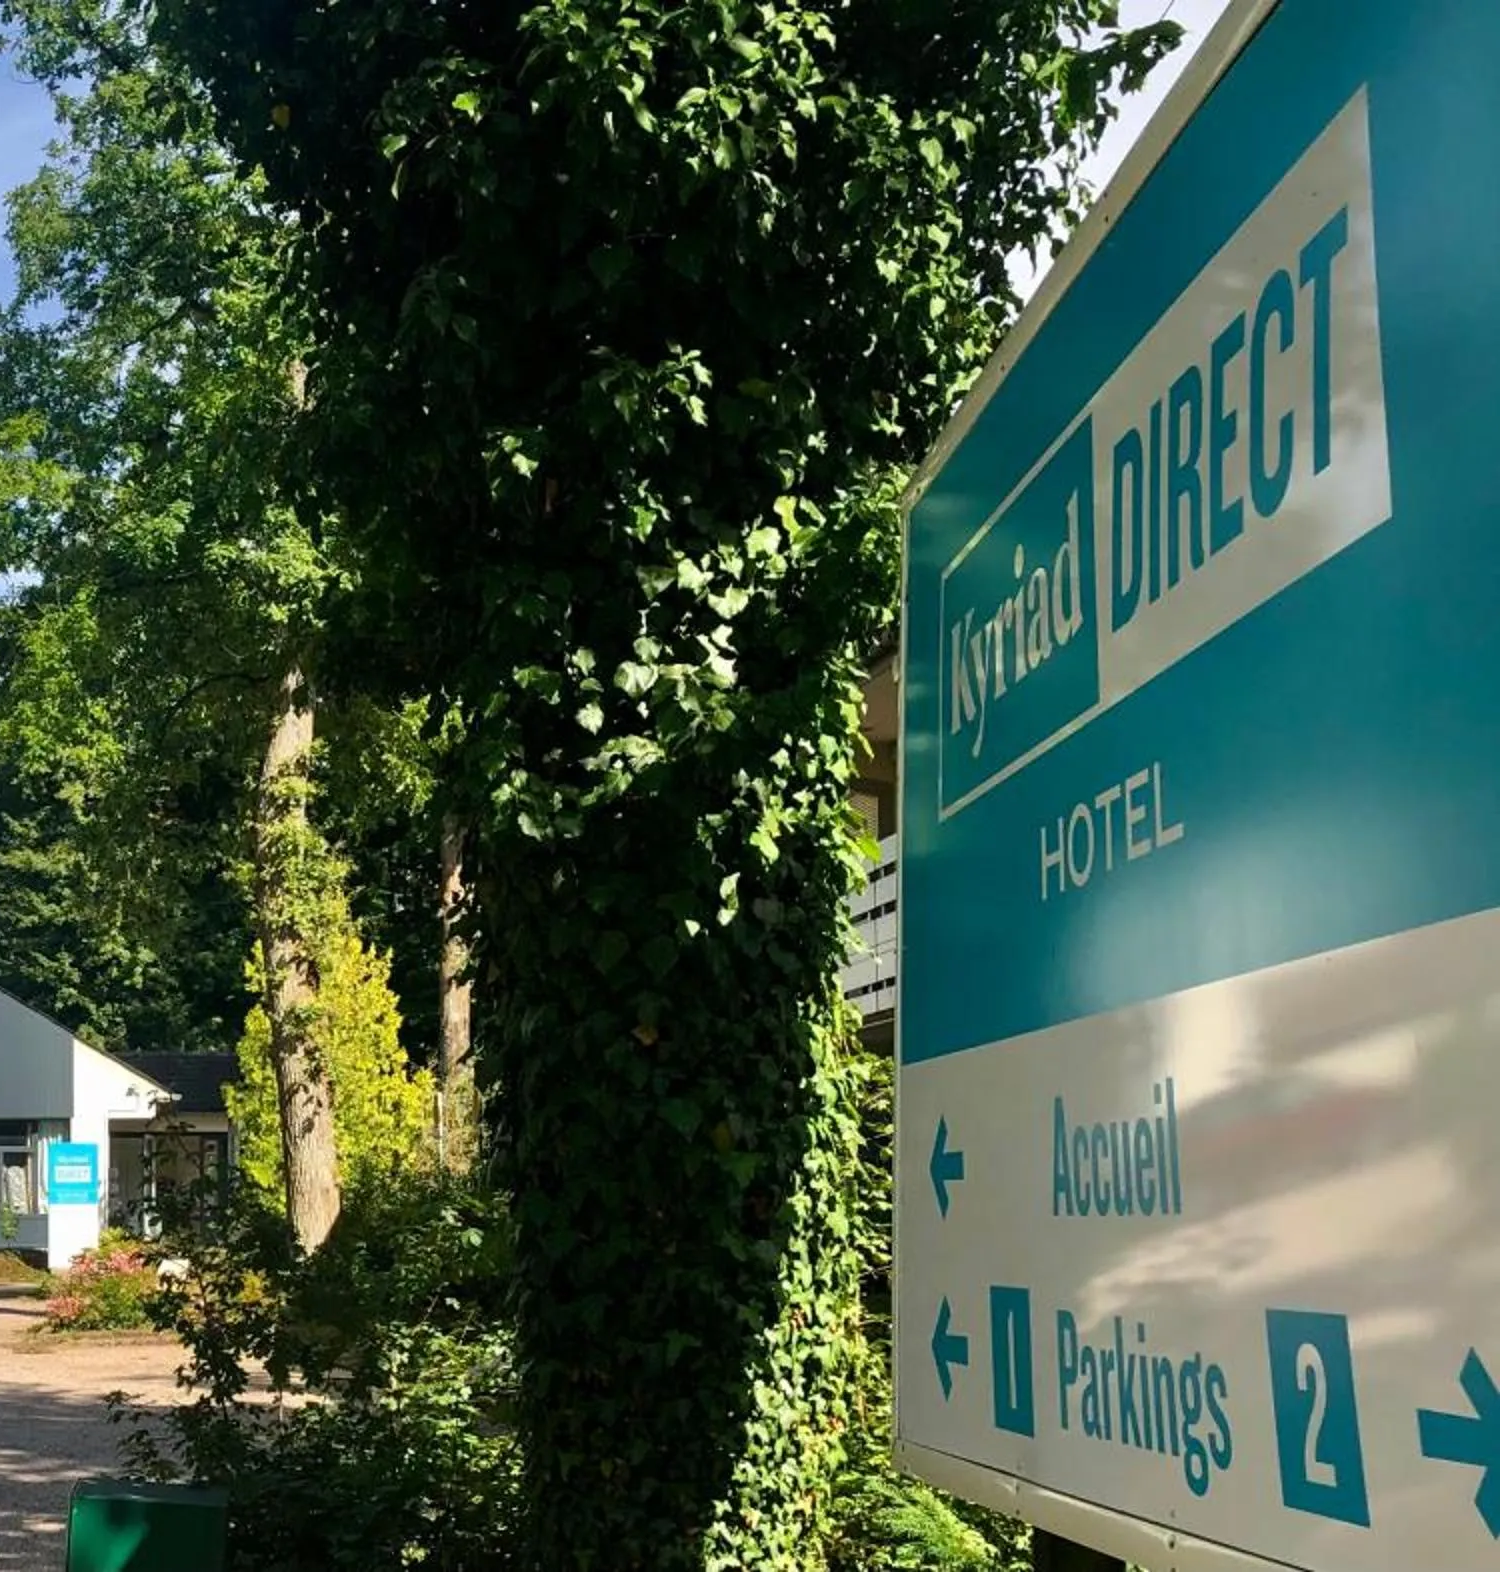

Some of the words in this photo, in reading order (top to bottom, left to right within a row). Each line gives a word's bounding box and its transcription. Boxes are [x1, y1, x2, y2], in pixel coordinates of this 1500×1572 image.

[951, 487, 1084, 758] Kyriad
[1112, 206, 1348, 633] DIRECT
[1041, 762, 1184, 901] HOTEL
[1052, 1077, 1183, 1217] Accueil
[1006, 1309, 1018, 1410] 1
[1056, 1309, 1232, 1497] Parkings
[1296, 1343, 1338, 1488] 2
